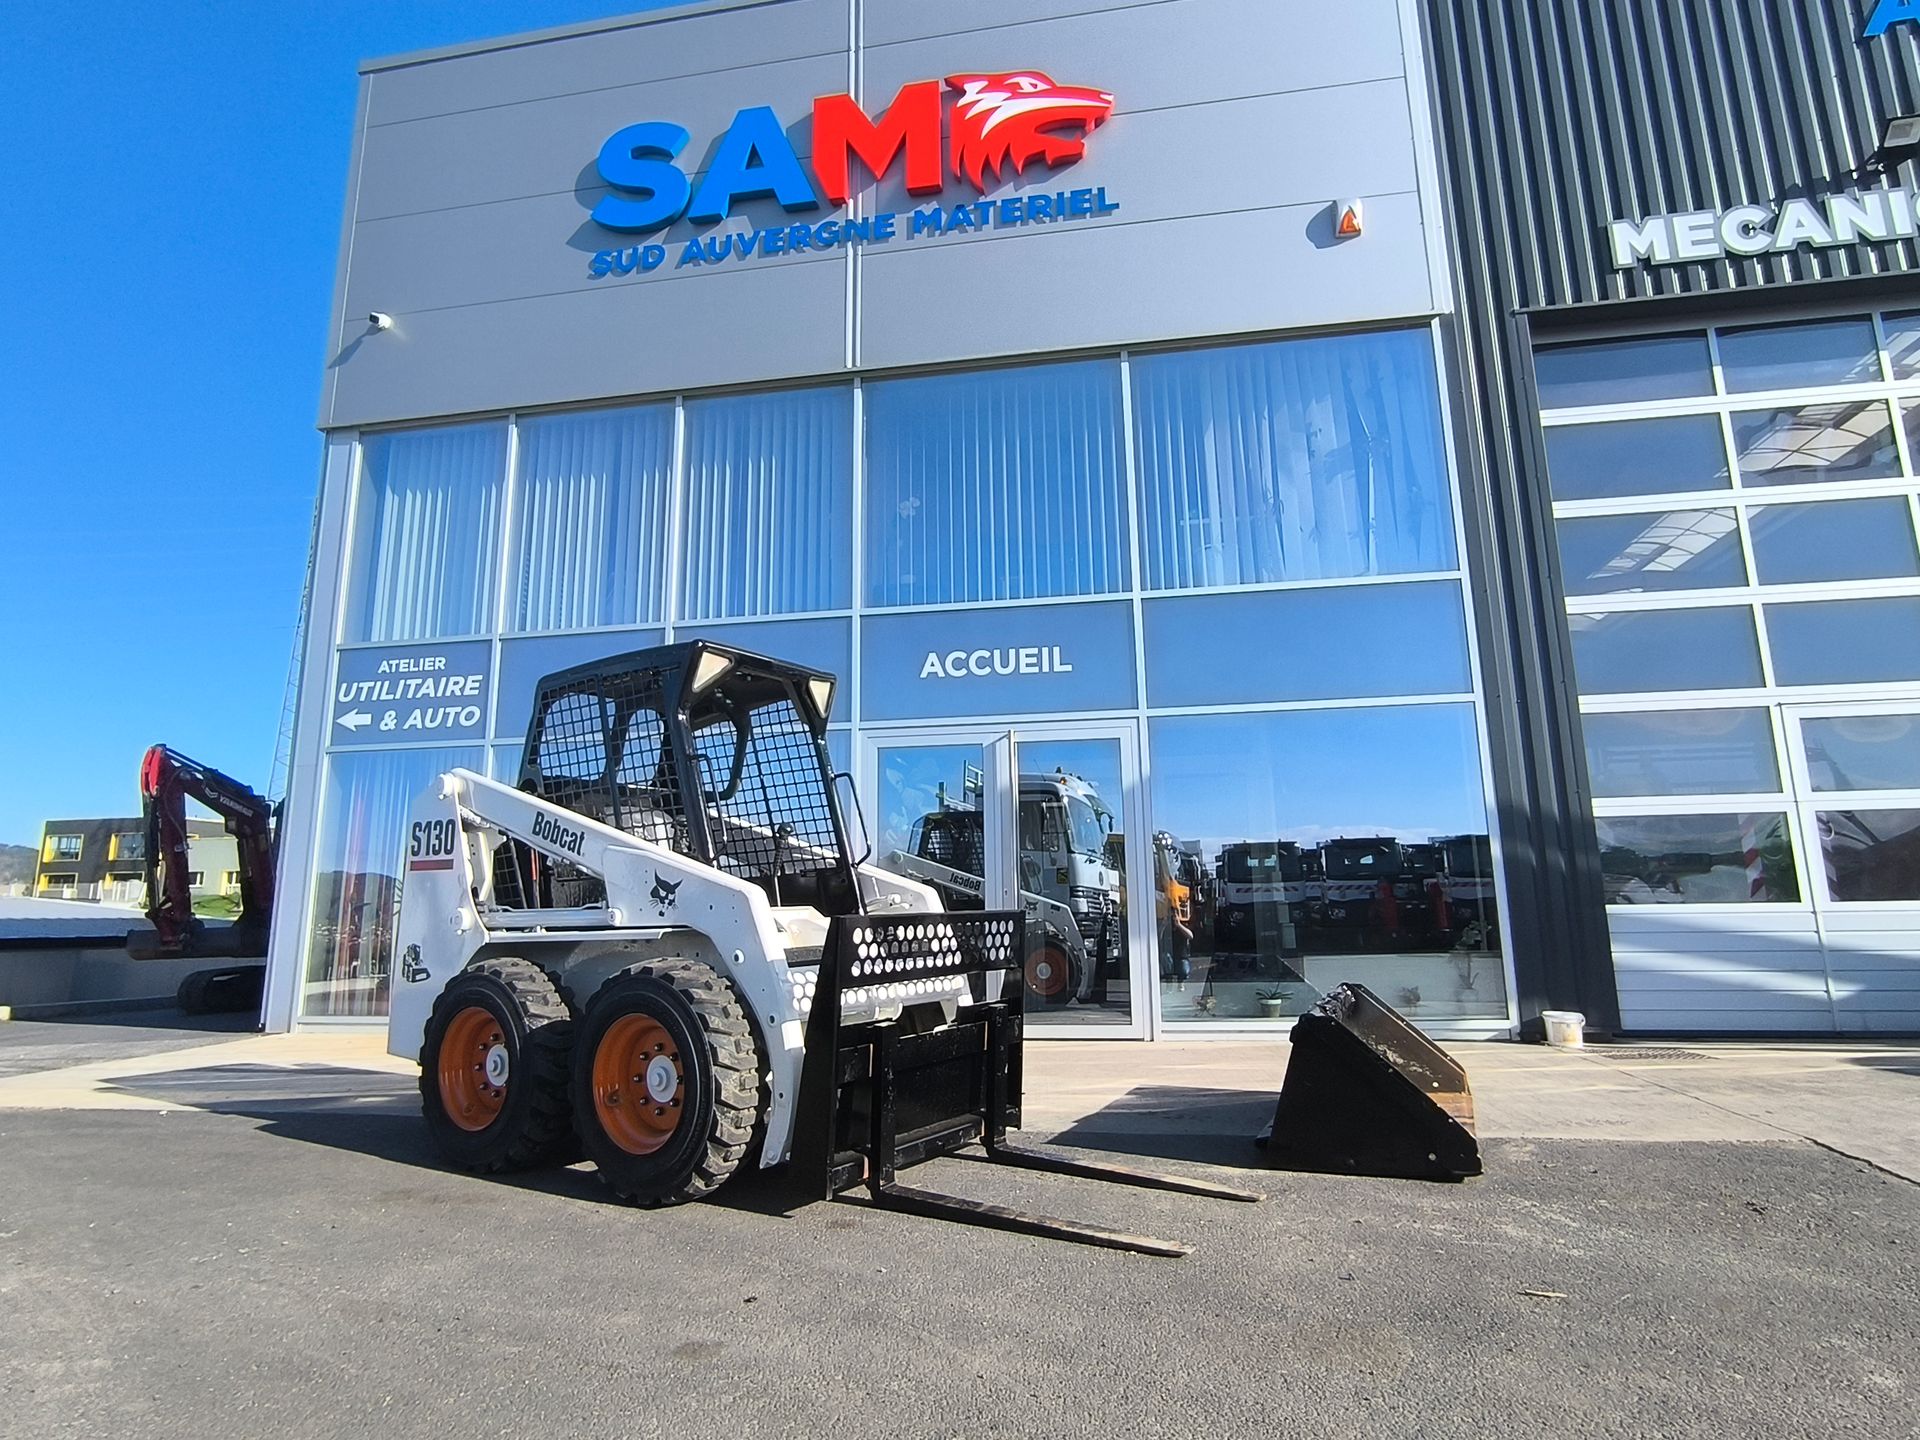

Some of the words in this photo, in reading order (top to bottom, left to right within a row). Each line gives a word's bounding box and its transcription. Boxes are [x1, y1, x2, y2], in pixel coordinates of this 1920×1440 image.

[590, 79, 944, 235] SAM
[592, 242, 666, 278] SUD
[681, 213, 897, 269] AUVERGNE
[912, 186, 1121, 236] MATERIEL
[1611, 189, 1920, 262] MECANI
[377, 656, 446, 674] ATELIER
[919, 646, 1073, 679] ACCUEIL
[338, 674, 483, 703] UTILITAIRE
[379, 709, 398, 731] &
[402, 705, 481, 730] AUTO
[410, 818, 456, 857] S130
[531, 810, 586, 857] Bobcat
